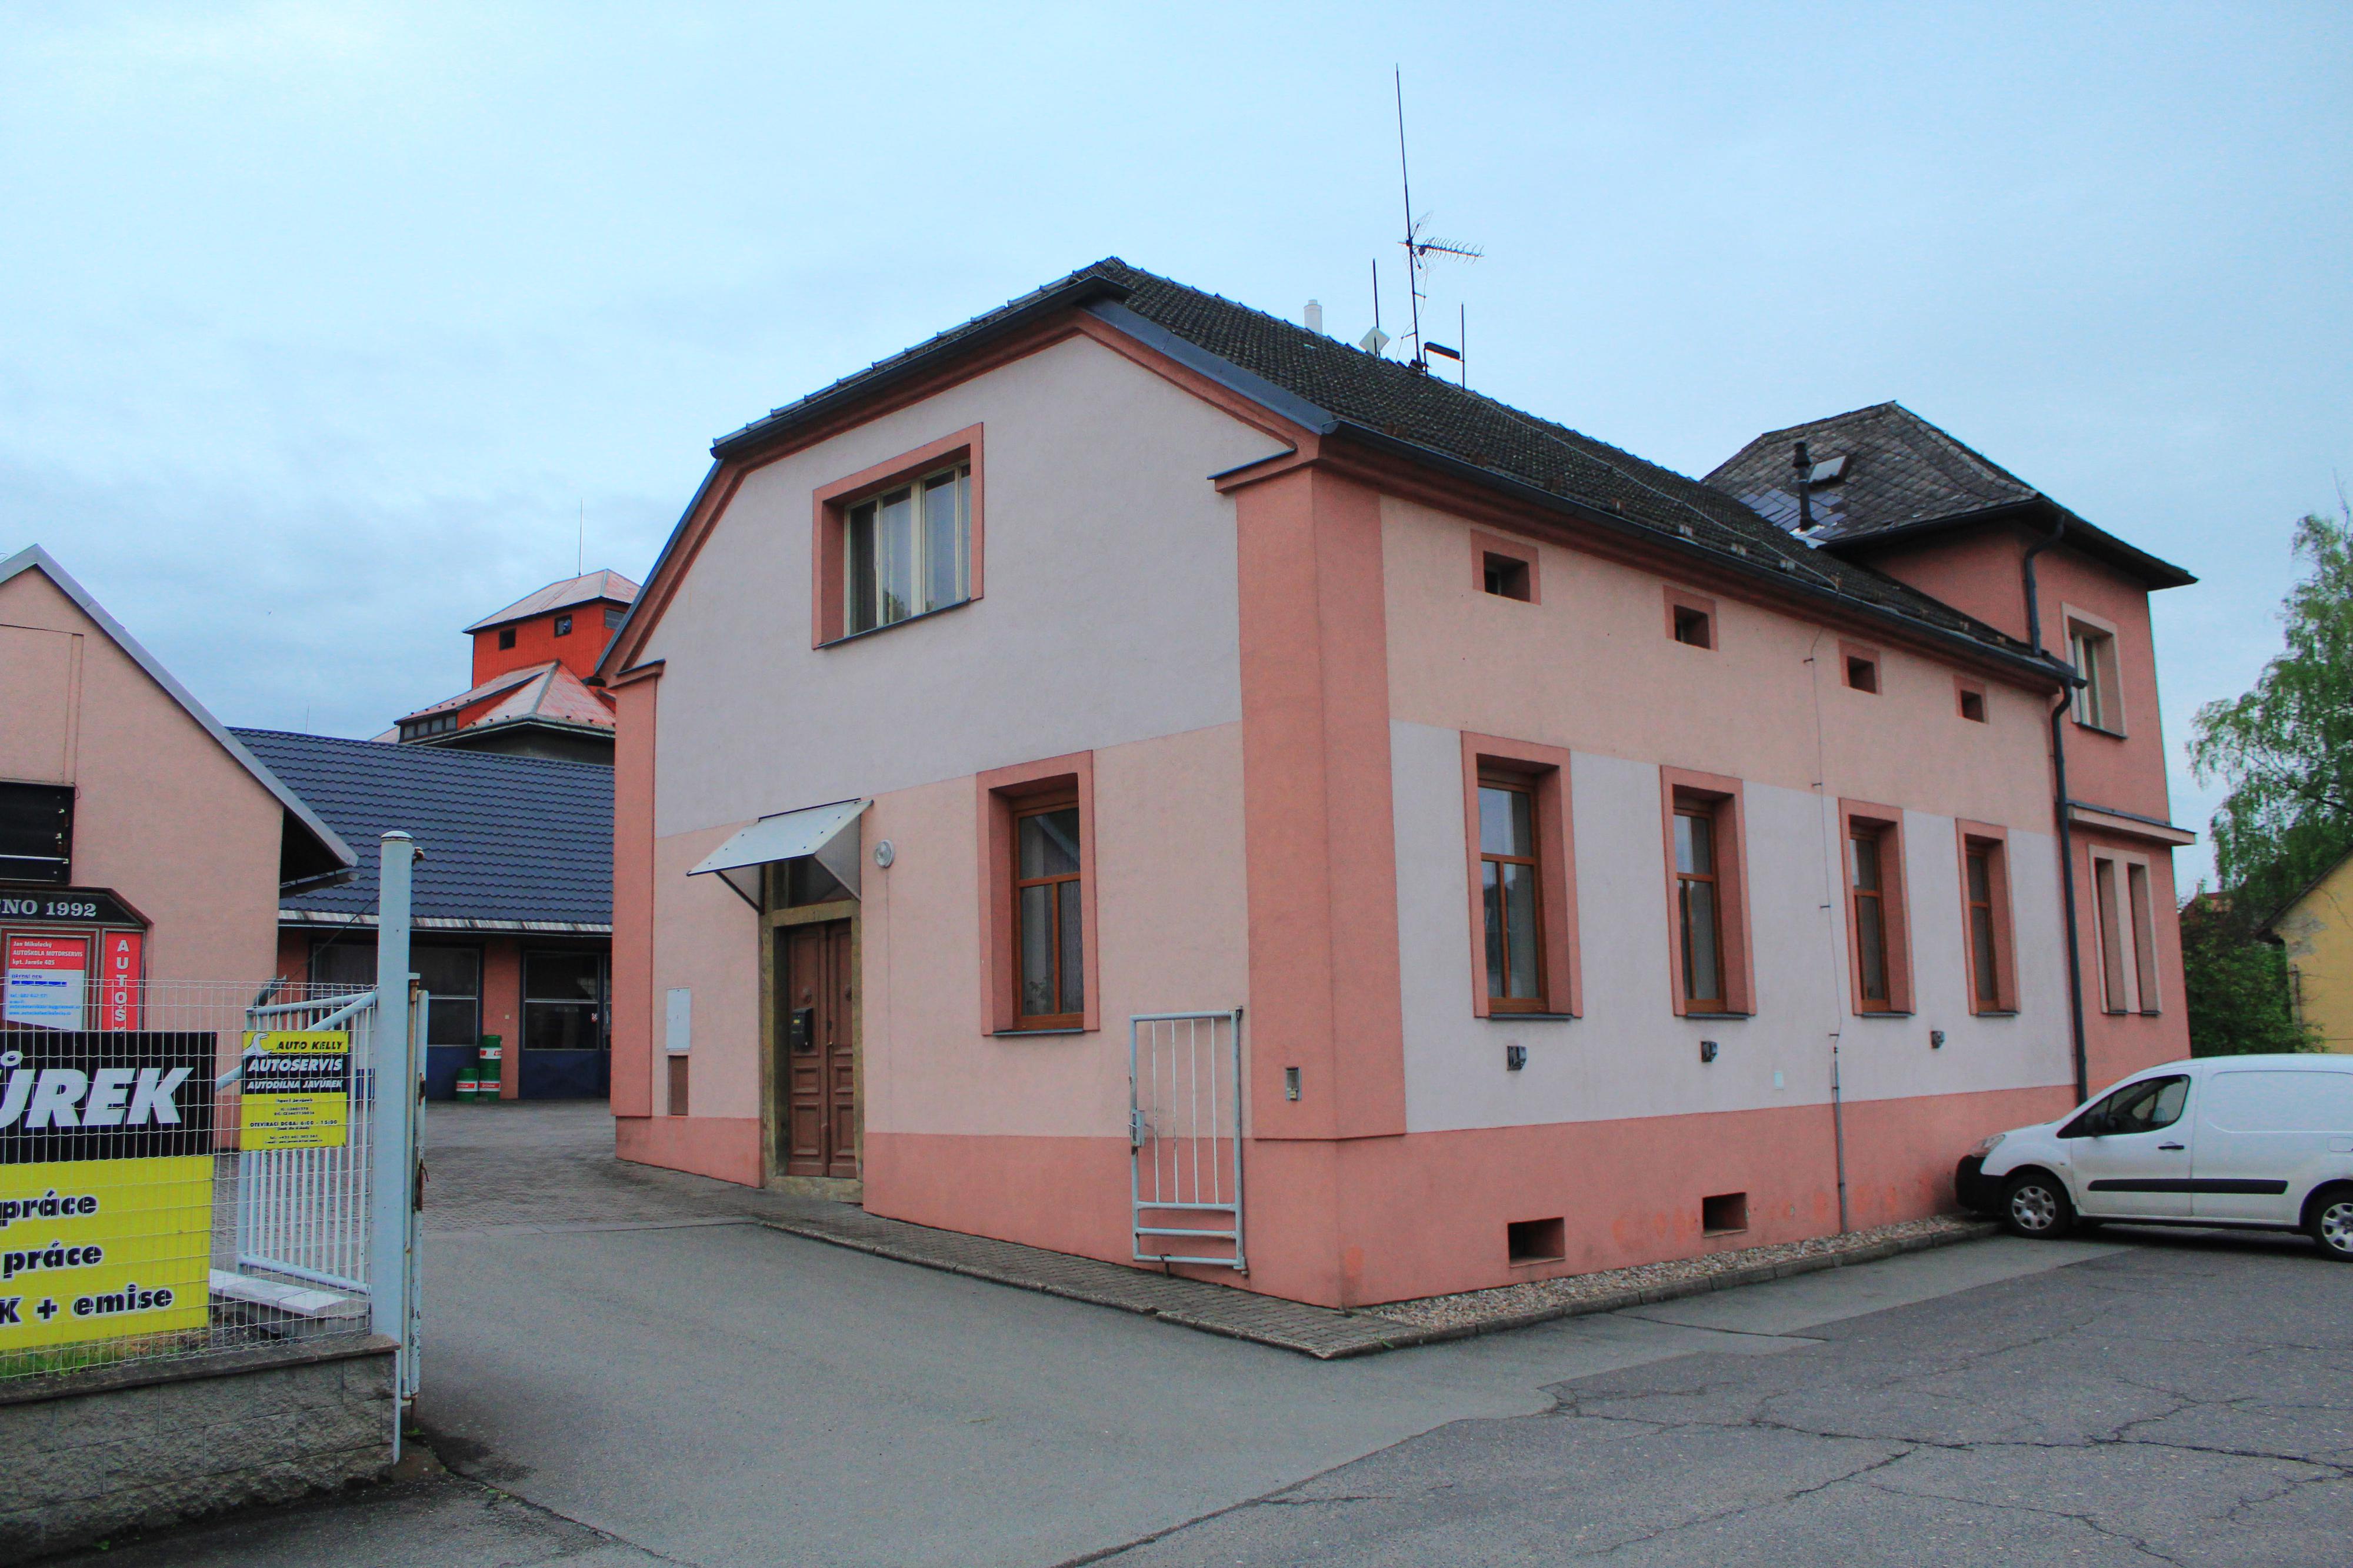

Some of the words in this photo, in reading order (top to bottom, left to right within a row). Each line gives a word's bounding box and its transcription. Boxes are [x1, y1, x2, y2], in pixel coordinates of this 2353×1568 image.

[0, 899, 38, 914] NO
[46, 902, 96, 917] 1992
[276, 1041, 308, 1050] AUTO
[311, 1041, 344, 1050] KELLY
[247, 1059, 344, 1072] AUTOSERVIS
[0, 1190, 96, 1227] práce
[4, 1240, 102, 1279] práce
[74, 1284, 172, 1316] emise
